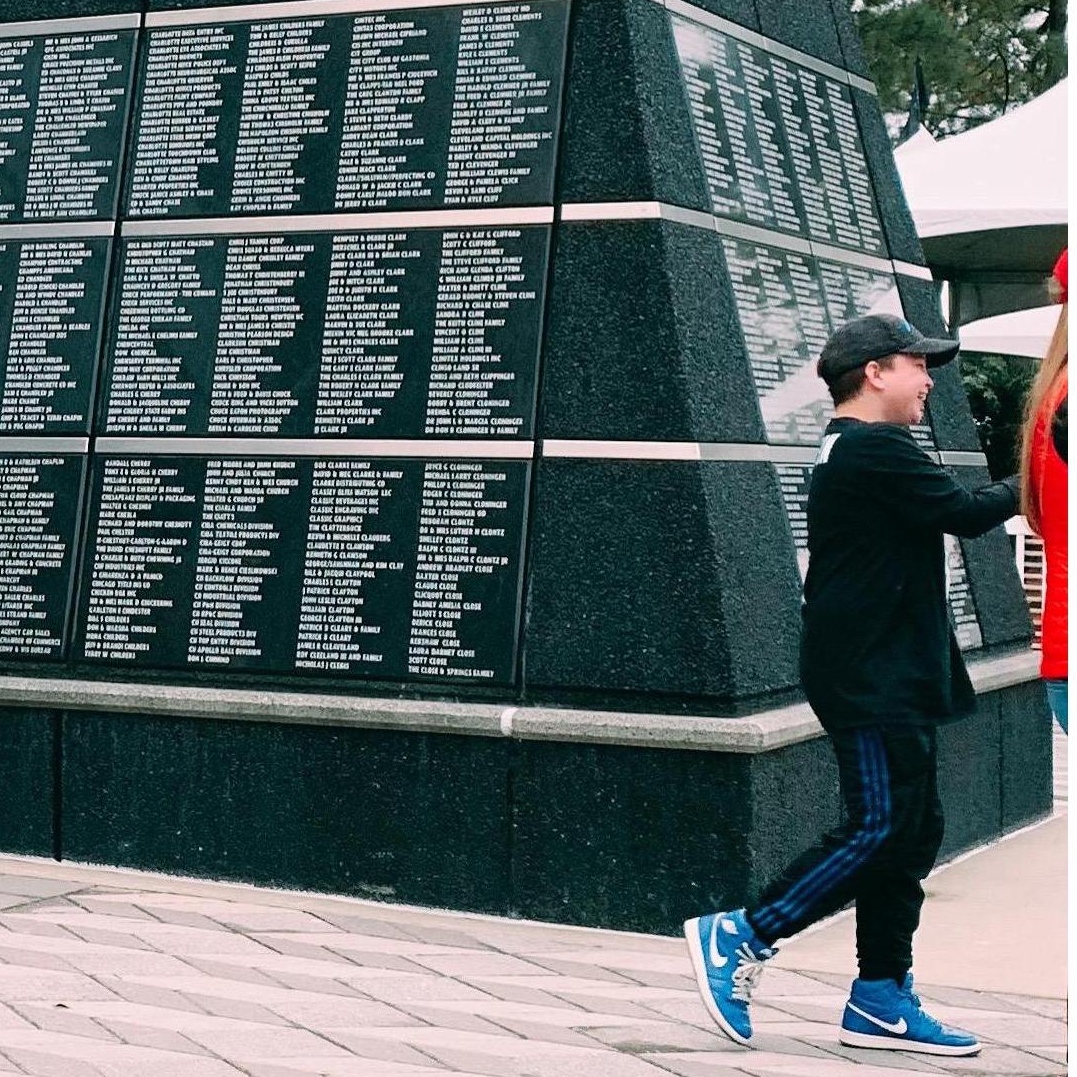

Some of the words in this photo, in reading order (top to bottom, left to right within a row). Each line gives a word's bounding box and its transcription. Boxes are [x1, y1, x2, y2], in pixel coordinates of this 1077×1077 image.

[449, 126, 484, 134] CLEVELAND
[485, 125, 511, 133] BROWNS
[449, 135, 483, 143] CLEVELAND
[510, 132, 540, 140] HOLDINGS
[360, 148, 379, 156] CLARK
[308, 514, 332, 522] CLASSIC
[333, 515, 363, 523] GRAPHICS
[440, 573, 459, 581] CLOSE
[438, 582, 457, 590] CLOSE
[411, 609, 436, 617] ELLIOTT
[442, 610, 461, 618] CLOSE
[410, 628, 437, 636] FRANCES
[438, 629, 456, 637] CLOSE
[441, 639, 460, 647] CLOSE
[456, 649, 475, 657] CLOSE
[408, 656, 427, 664] SCOTT
[428, 657, 447, 665] CLOSE
[420, 666, 438, 674] CLOSE
[472, 668, 494, 677] FAMILY
